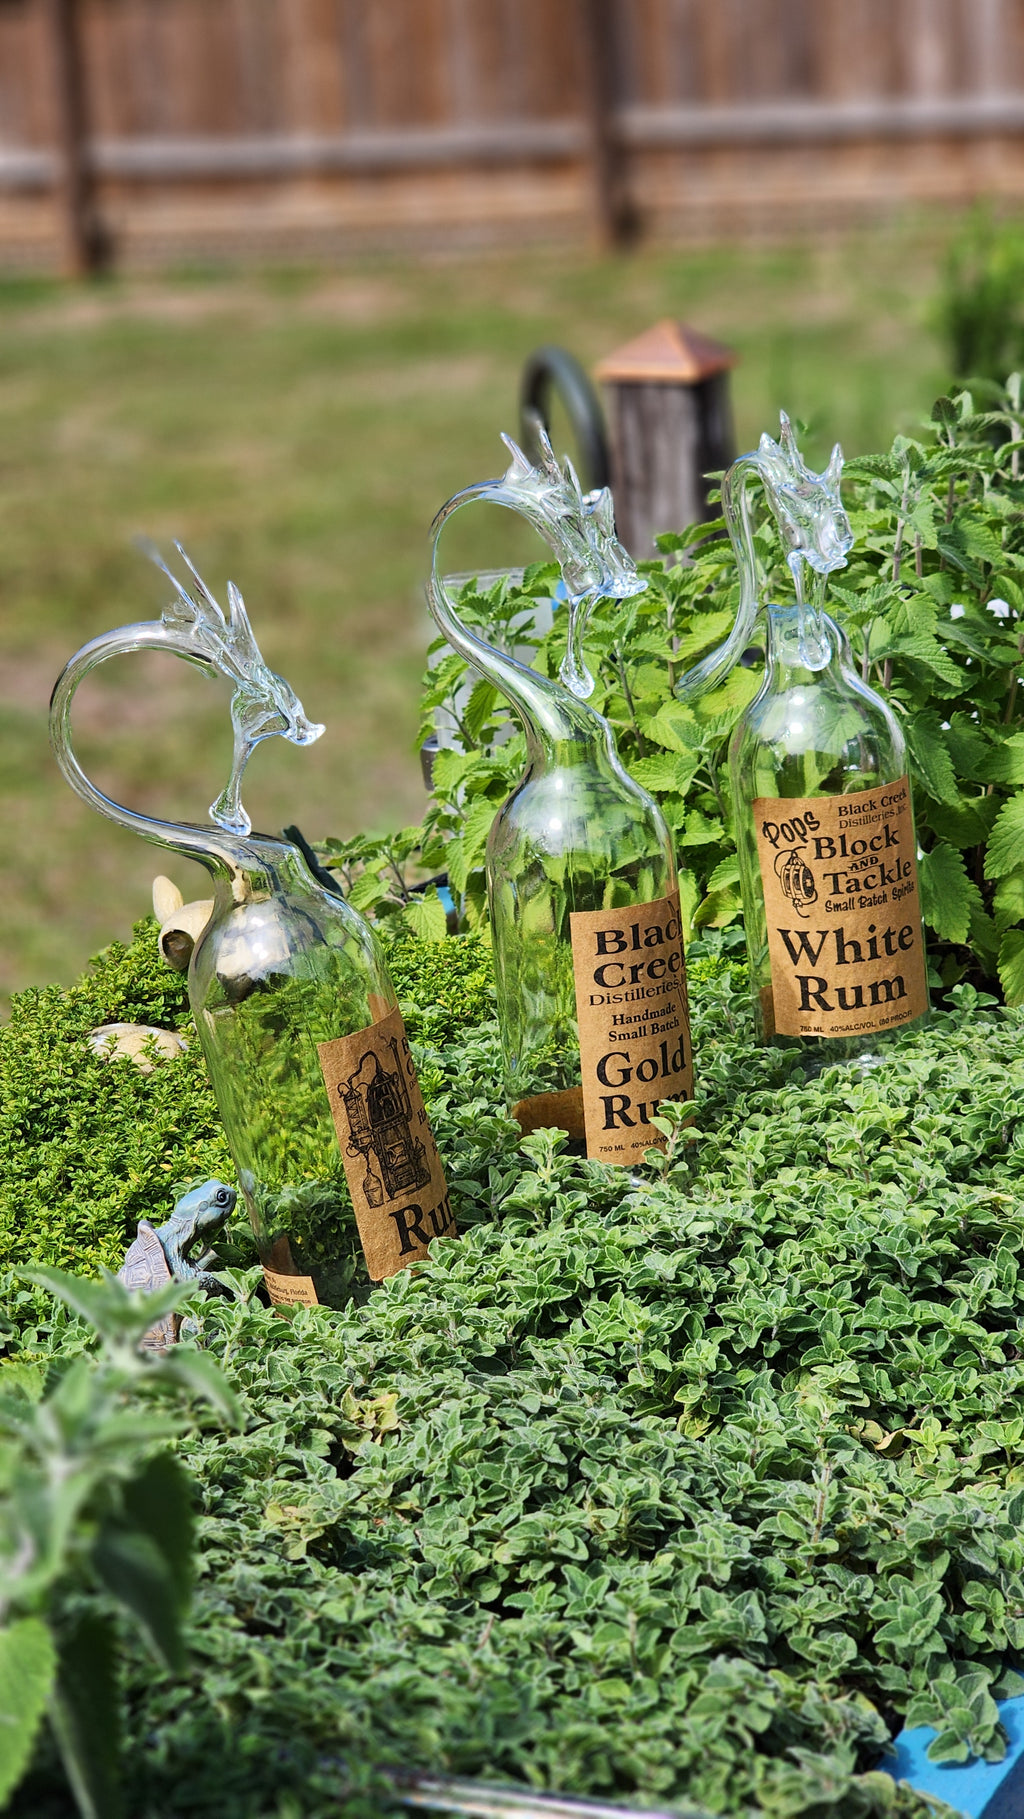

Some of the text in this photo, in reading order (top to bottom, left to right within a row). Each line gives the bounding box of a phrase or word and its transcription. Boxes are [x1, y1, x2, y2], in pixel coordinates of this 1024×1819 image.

[838, 800, 877, 817] Black
[761, 811, 820, 849] Pops
[812, 824, 900, 860] Block
[823, 860, 912, 896] Tackle
[849, 856, 879, 871] AND
[824, 881, 915, 913] Small Batch Spirits
[777, 923, 914, 967] White
[794, 973, 908, 1012] Rum
[608, 1016, 680, 1043] Small Batch
[612, 1002, 677, 1027] Handmade
[596, 1033, 687, 1088] Gold
[614, 1144, 625, 1152] ML
